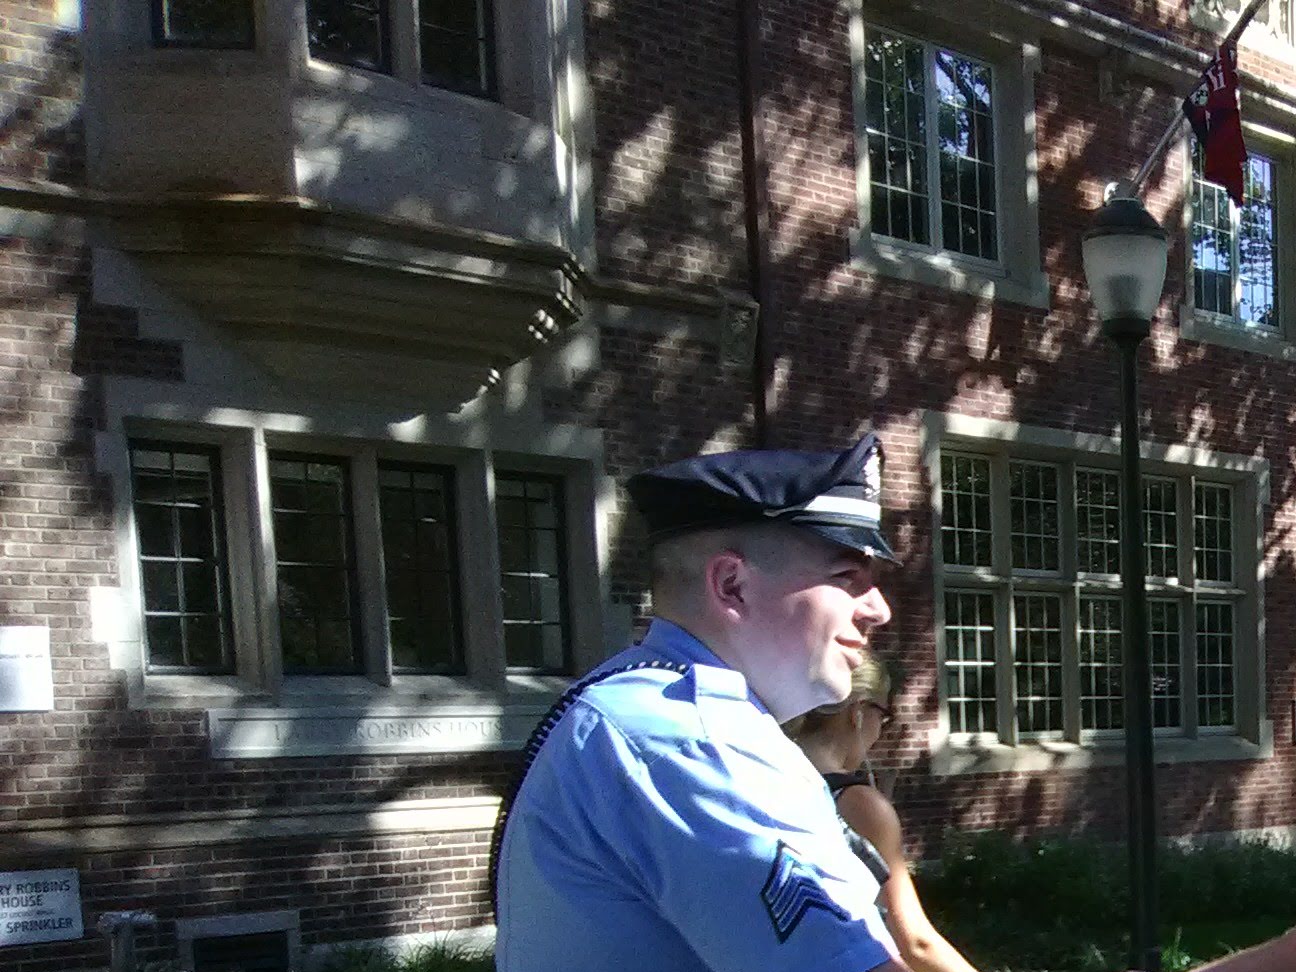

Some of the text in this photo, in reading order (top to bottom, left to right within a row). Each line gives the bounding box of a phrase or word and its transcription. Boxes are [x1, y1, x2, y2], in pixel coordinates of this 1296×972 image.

[16, 880, 70, 894] ROBBINS
[1, 894, 43, 908] HOUSE
[6, 917, 74, 933] SPRINKLER
